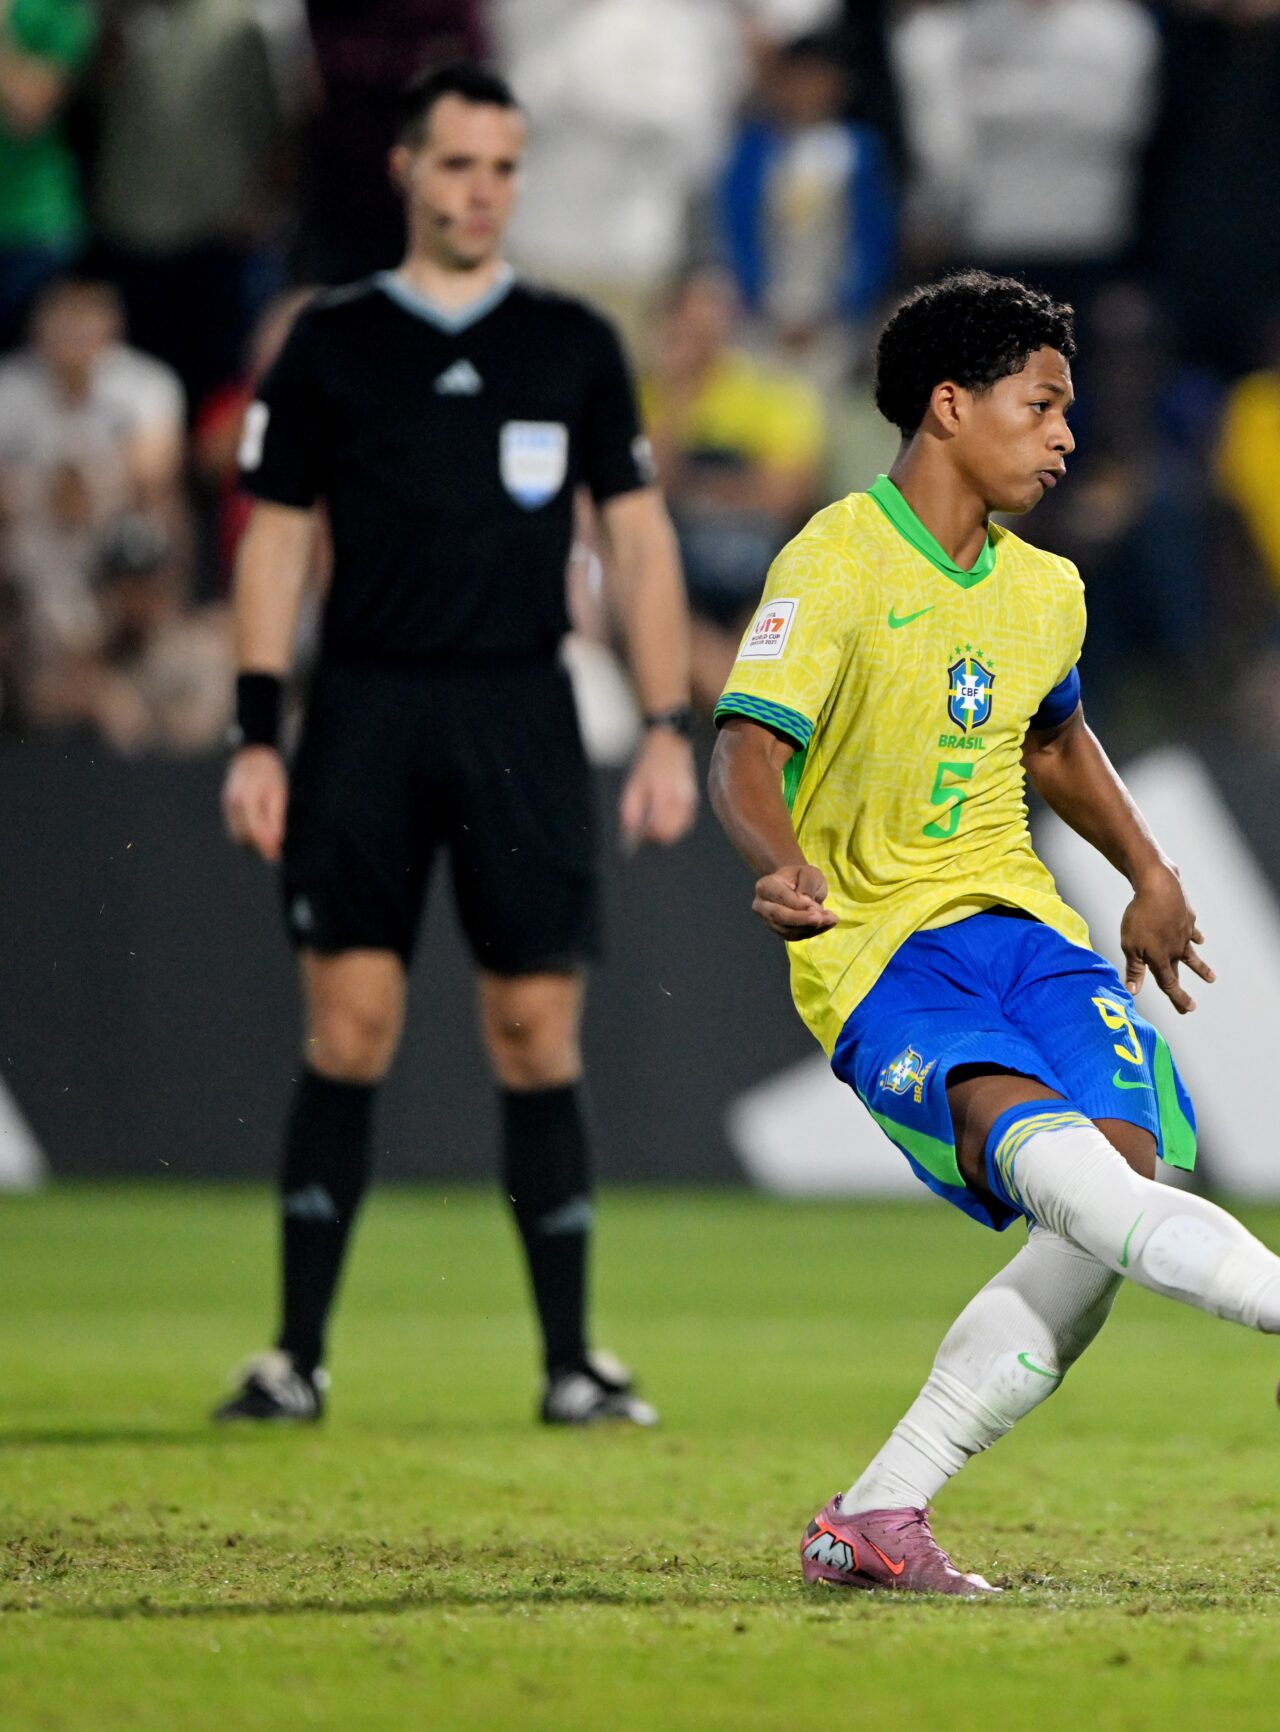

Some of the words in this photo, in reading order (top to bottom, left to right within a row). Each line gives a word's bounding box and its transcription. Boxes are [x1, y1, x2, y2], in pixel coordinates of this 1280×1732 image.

[961, 687, 980, 697] CBF
[938, 734, 987, 750] BRASIL
[922, 761, 975, 839] 5
